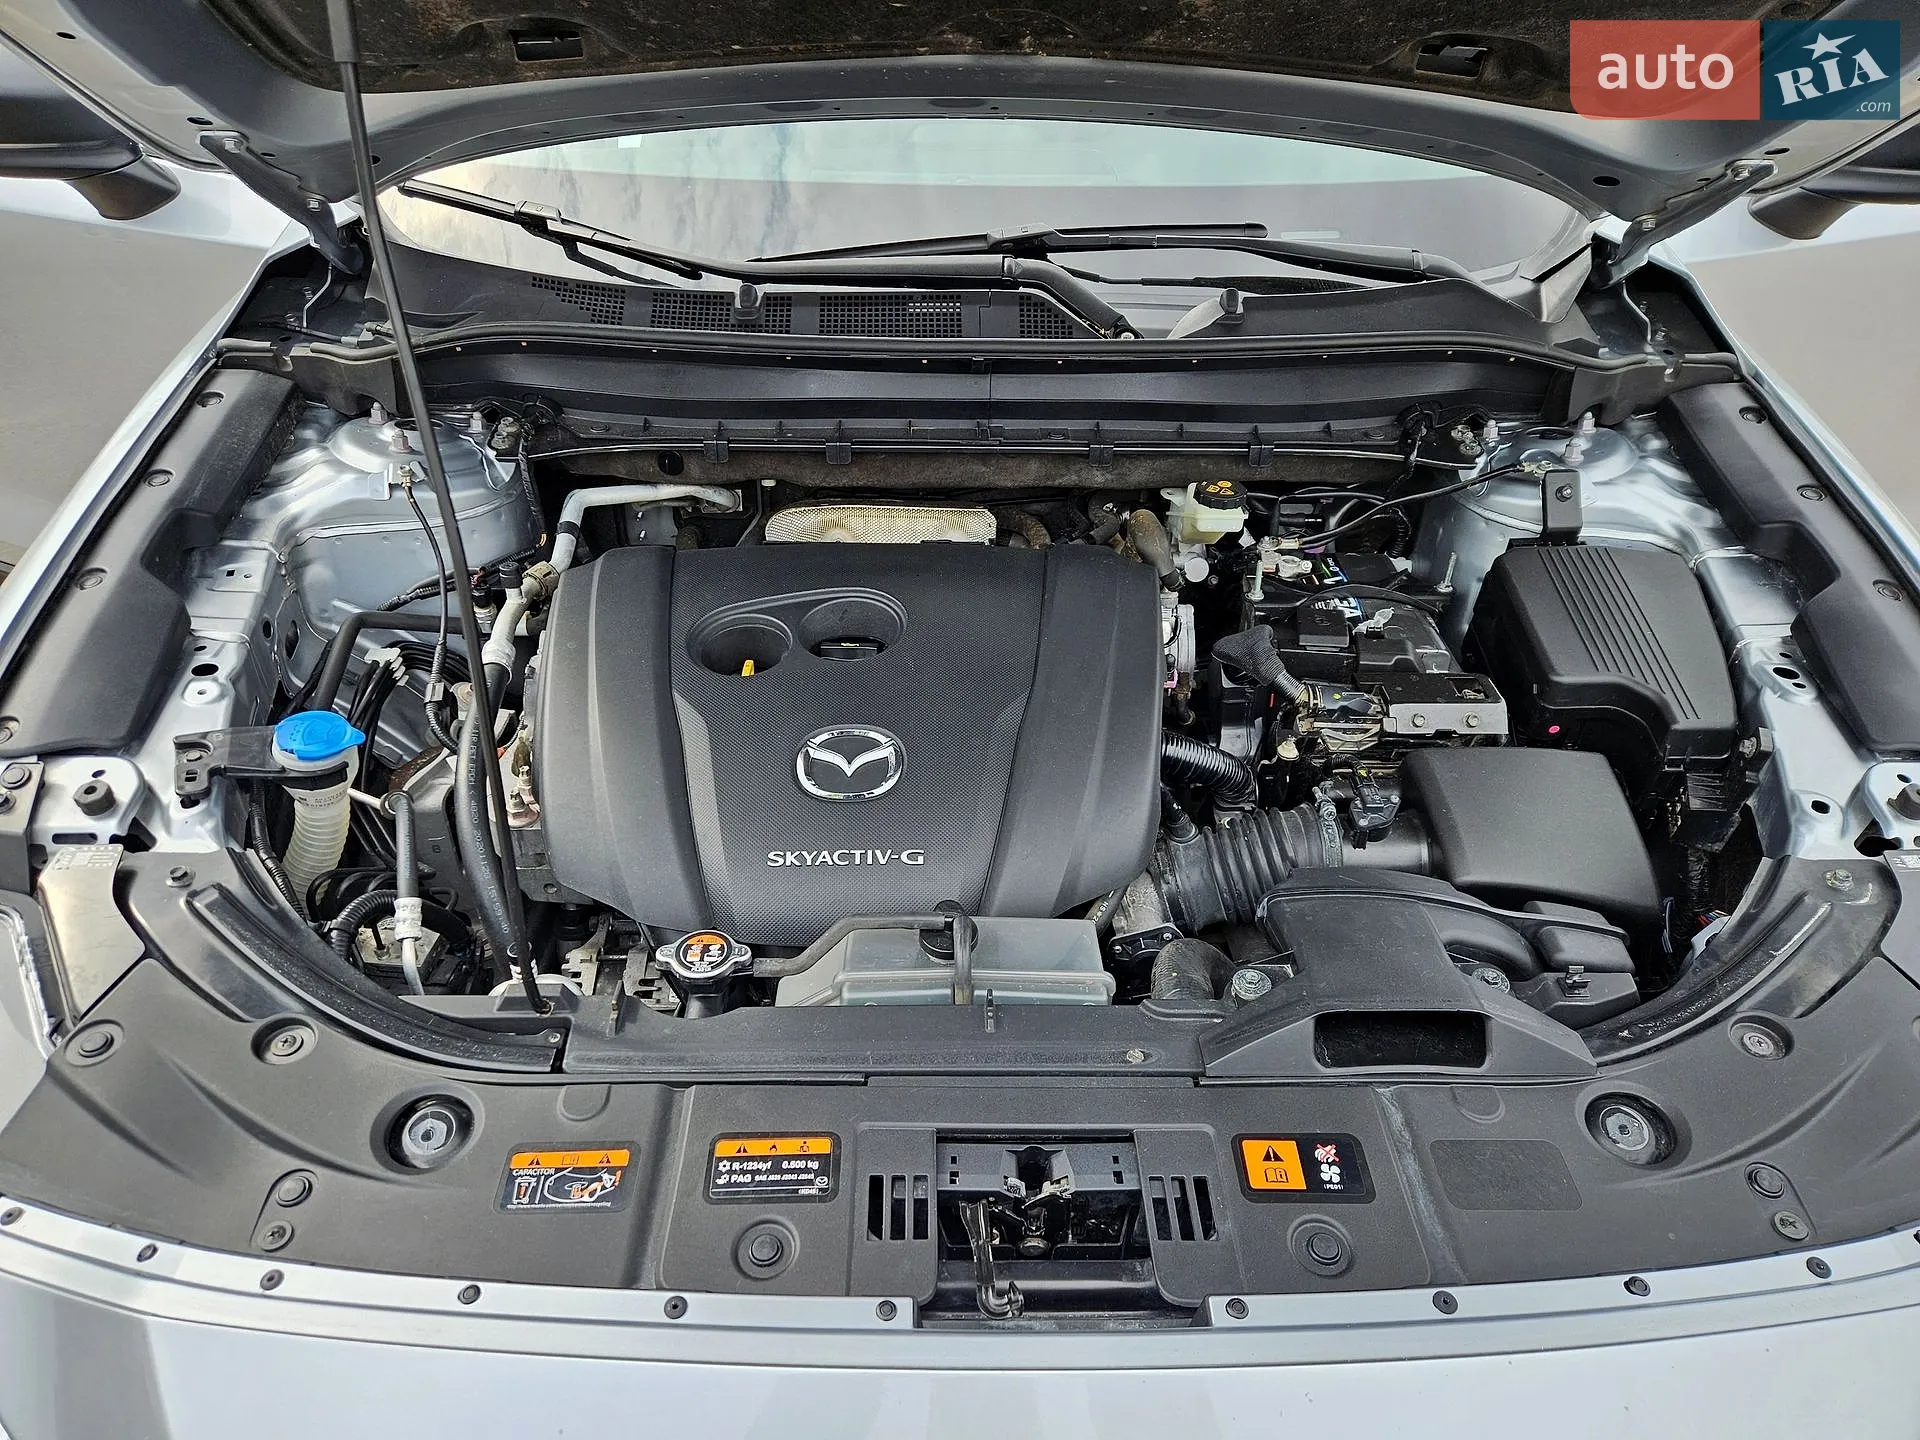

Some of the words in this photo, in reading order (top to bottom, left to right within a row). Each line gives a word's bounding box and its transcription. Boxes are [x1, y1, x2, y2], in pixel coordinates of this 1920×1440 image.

[767, 849, 925, 868] SKYACTIV-G
[807, 1160, 820, 1170] kg
[512, 1168, 556, 1176] CAPACITOR
[730, 1174, 752, 1183] PAG
